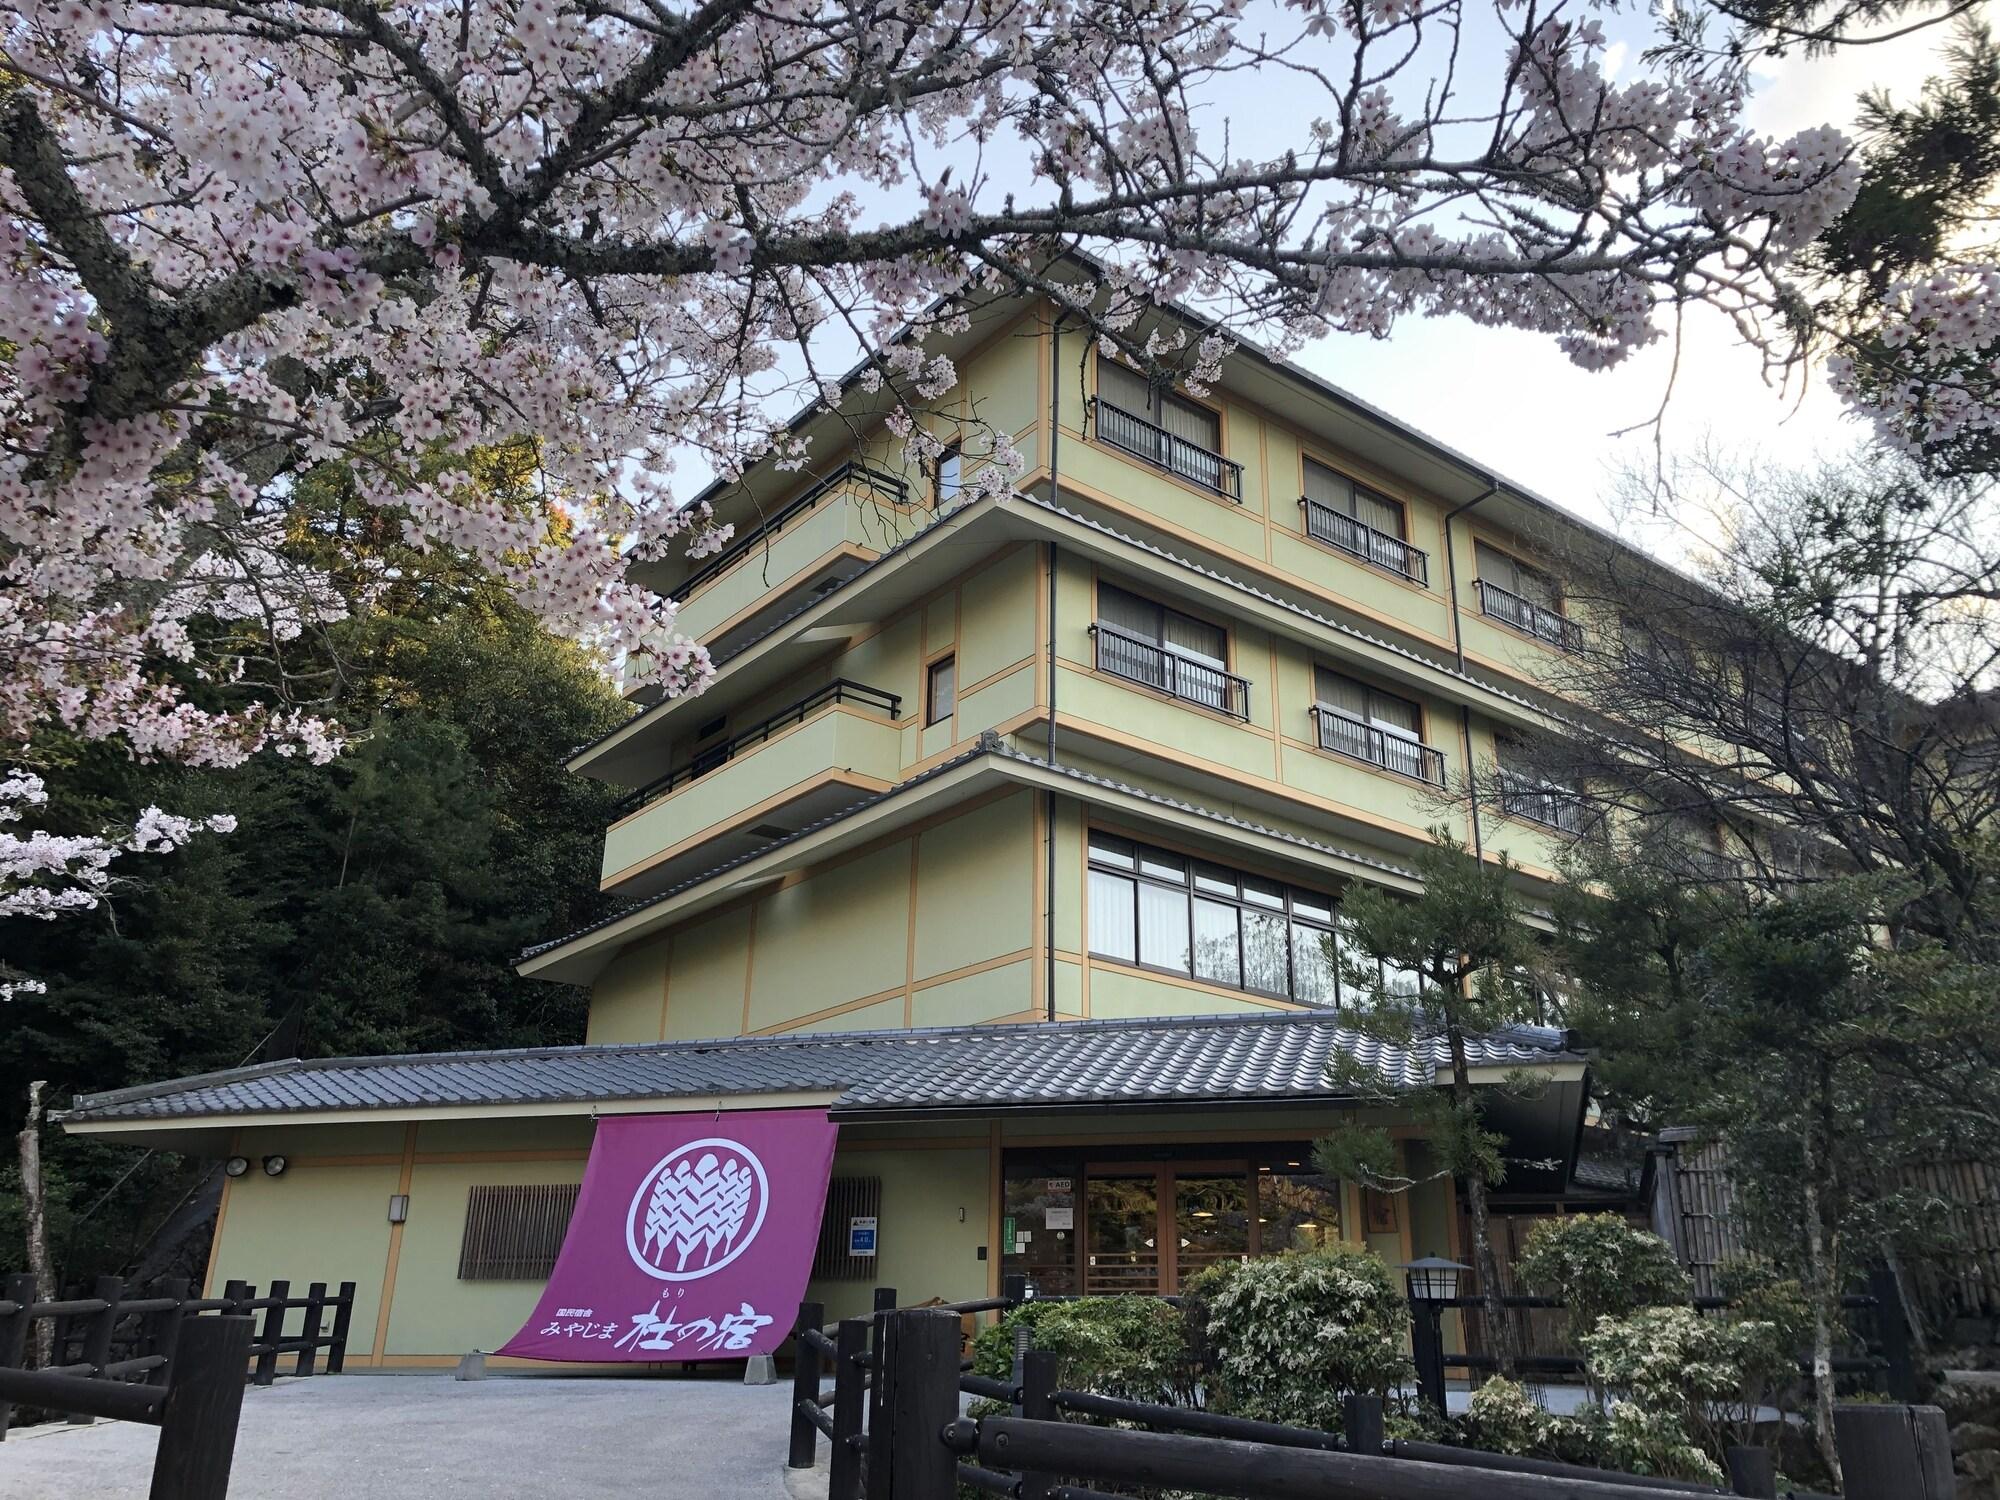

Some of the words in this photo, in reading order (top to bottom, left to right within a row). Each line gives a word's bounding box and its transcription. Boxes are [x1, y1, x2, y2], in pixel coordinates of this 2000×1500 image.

[662, 1287, 685, 1298] もり
[555, 1308, 593, 1318] 国民宿舎
[540, 1322, 619, 1340] みやじま
[614, 1300, 774, 1352] 杜の宿
